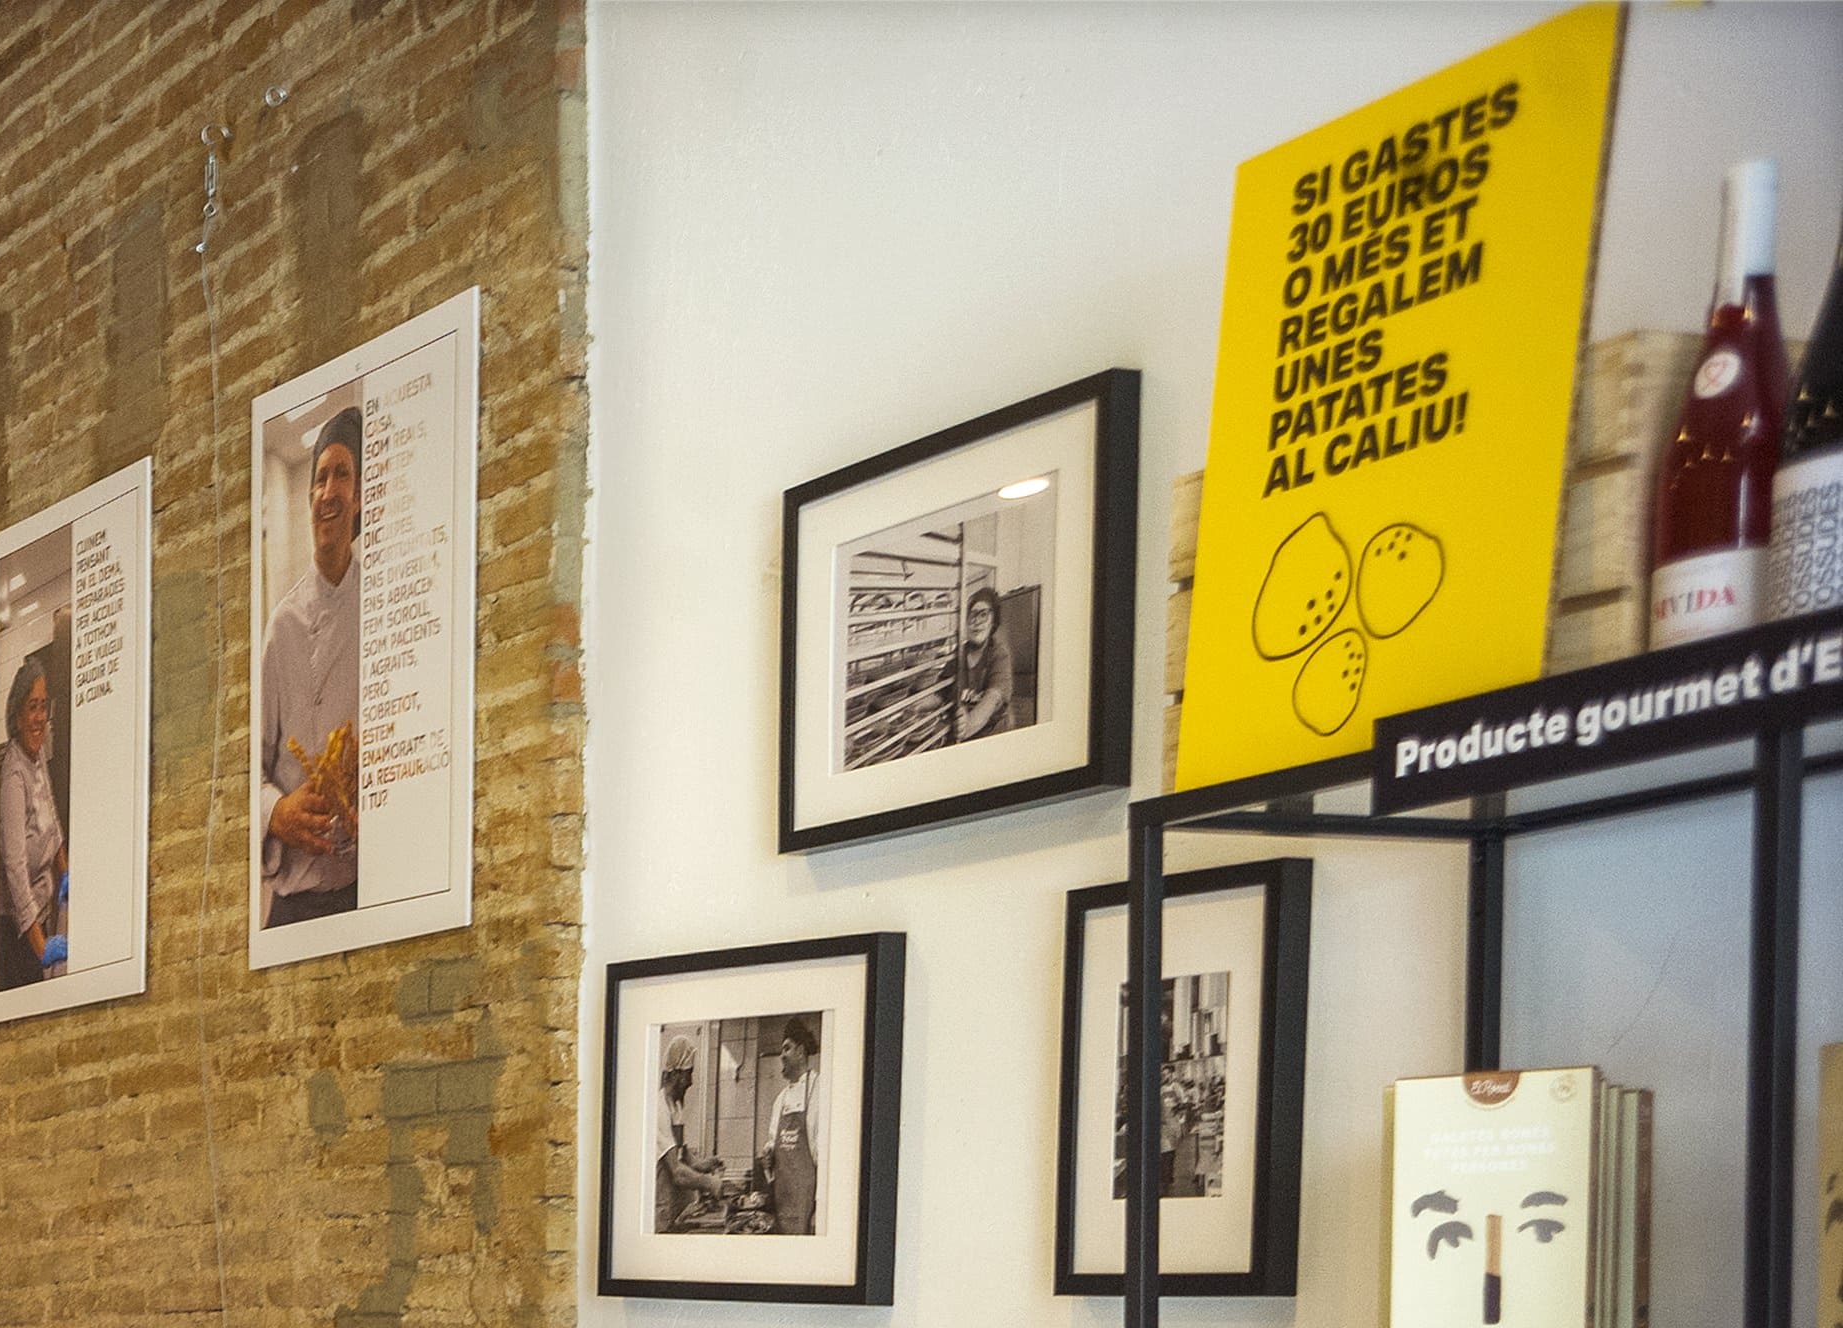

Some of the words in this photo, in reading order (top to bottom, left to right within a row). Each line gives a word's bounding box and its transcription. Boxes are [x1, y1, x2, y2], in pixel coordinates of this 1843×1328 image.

[1286, 213, 1331, 263] 30
[1341, 143, 1491, 243] EUROS
[1292, 164, 1332, 216] SI
[1340, 82, 1521, 195] GASTES
[1277, 240, 1485, 359] REGALEM
[1282, 267, 1313, 309] O
[1321, 229, 1410, 297] MÉS
[1420, 195, 1478, 254] ET
[1267, 351, 1449, 451] PATATES
[1274, 328, 1384, 402] UNES
[1262, 455, 1315, 499] AL
[1324, 391, 1469, 475] CALIU!
[1395, 711, 1567, 778] Producte
[1576, 655, 1765, 746] gourmet
